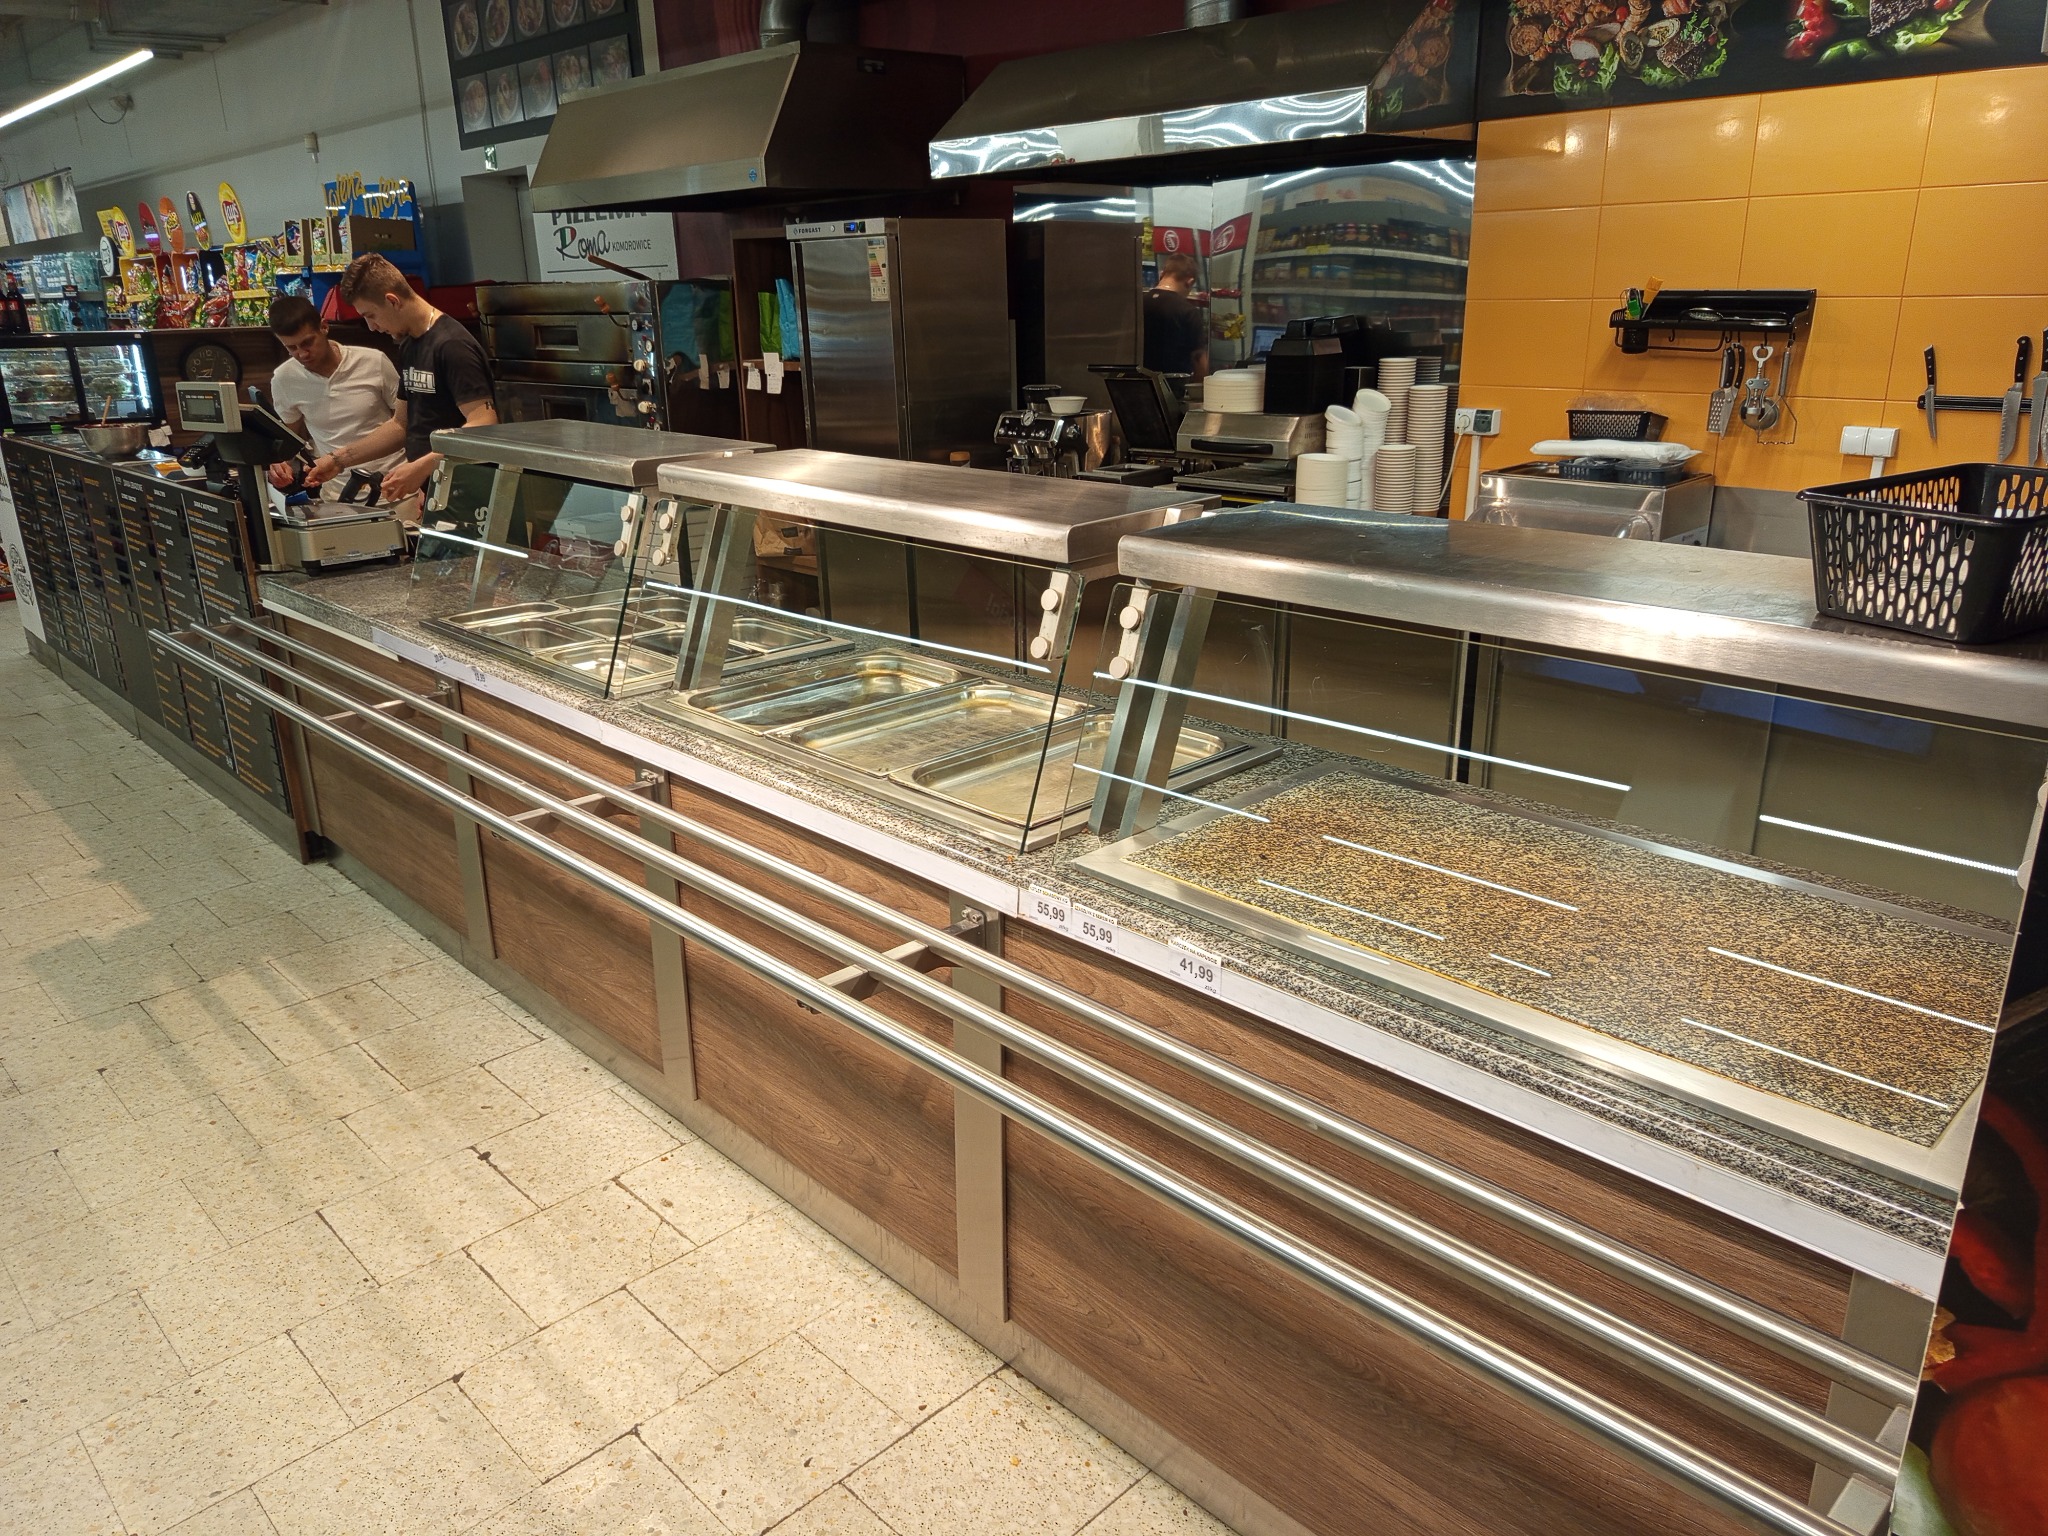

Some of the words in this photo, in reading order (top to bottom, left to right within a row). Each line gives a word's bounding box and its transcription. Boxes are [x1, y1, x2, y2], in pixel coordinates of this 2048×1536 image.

[553, 226, 611, 261] Roma
[612, 239, 652, 252] KOMOROWICE
[1037, 901, 1065, 922] 55,99
[1083, 921, 1112, 944] 55,99
[1180, 957, 1213, 982] 41,99
